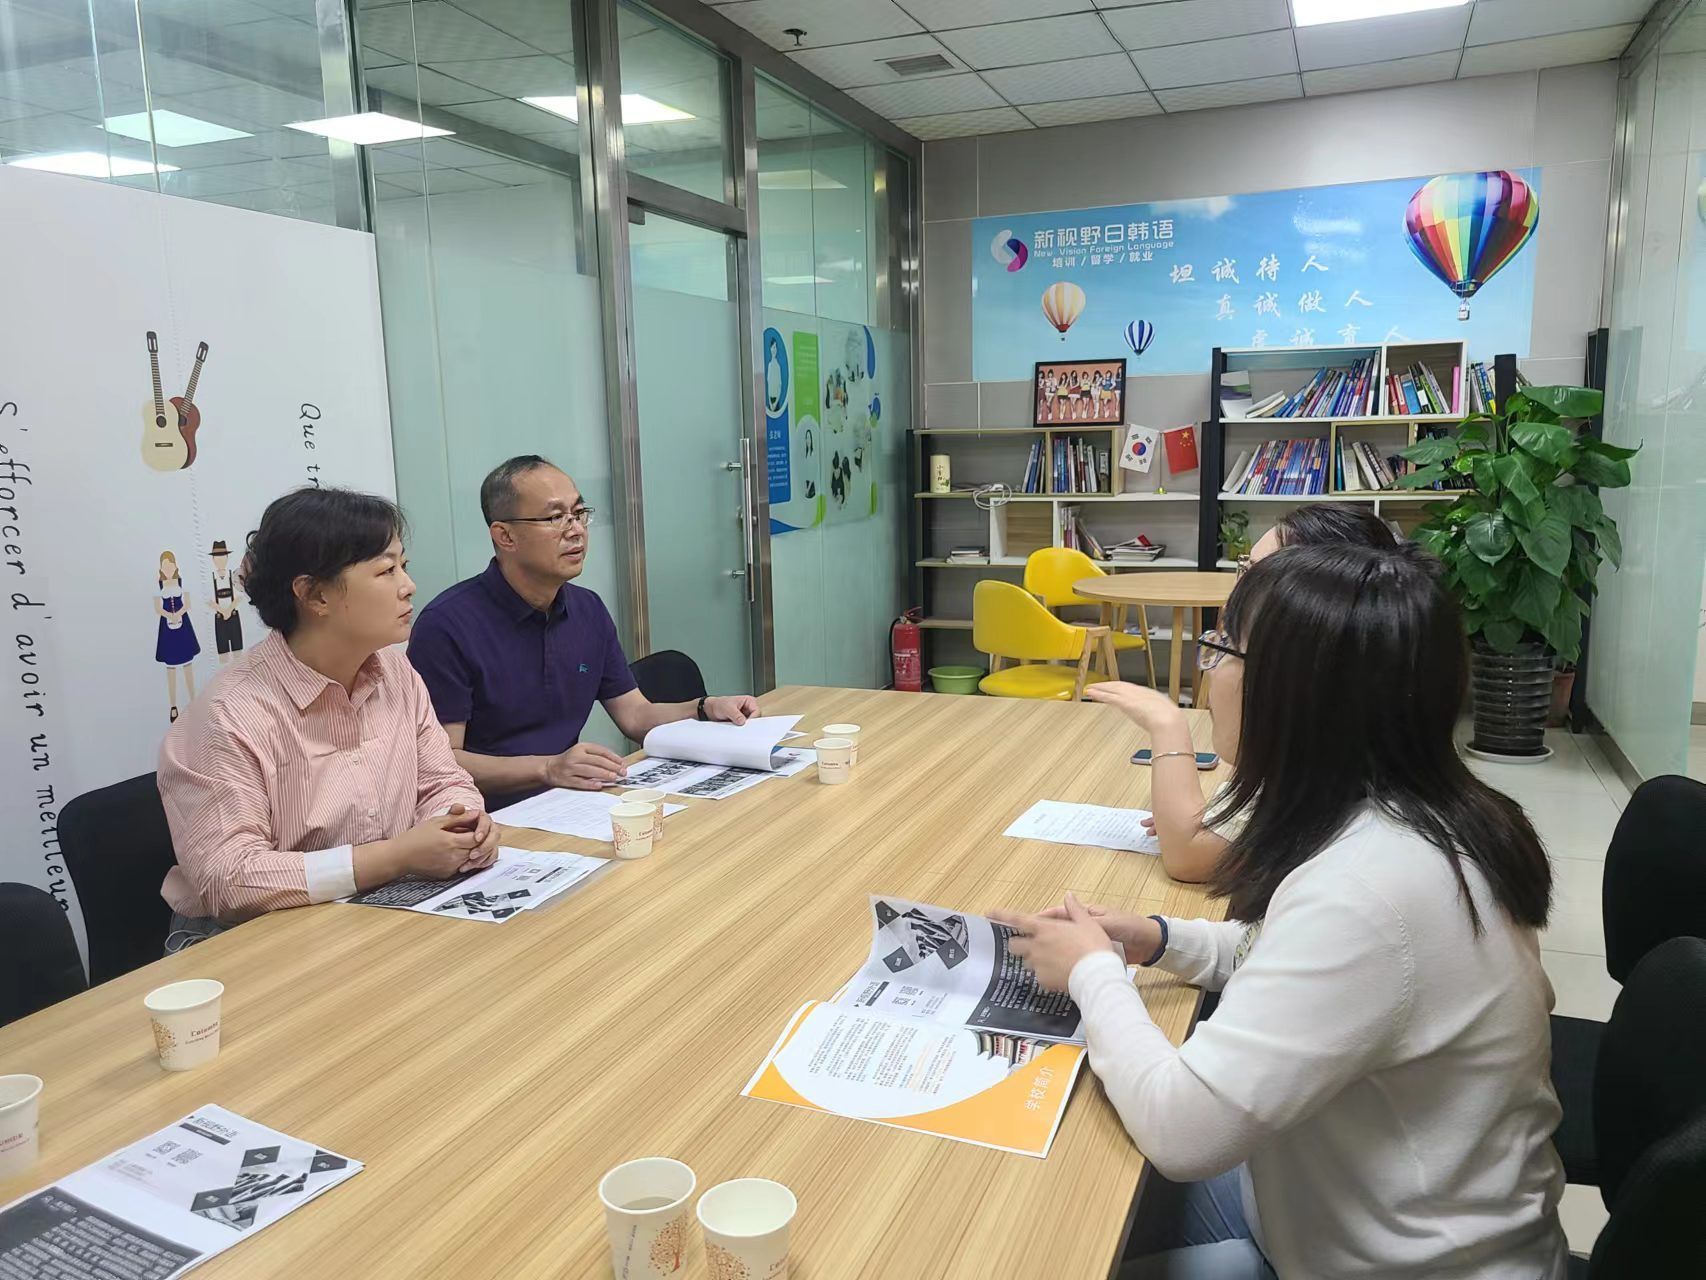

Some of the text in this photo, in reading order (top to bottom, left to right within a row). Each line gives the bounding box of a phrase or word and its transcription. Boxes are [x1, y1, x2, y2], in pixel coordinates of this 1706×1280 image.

[1033, 219, 1174, 249] 新视野日韩语
[1033, 240, 1174, 257] New Vision Foreign Language
[1129, 250, 1154, 263] 就业
[1215, 289, 1374, 321] 真诚做人
[299, 403, 322, 450] Que
[30, 733, 51, 771] un
